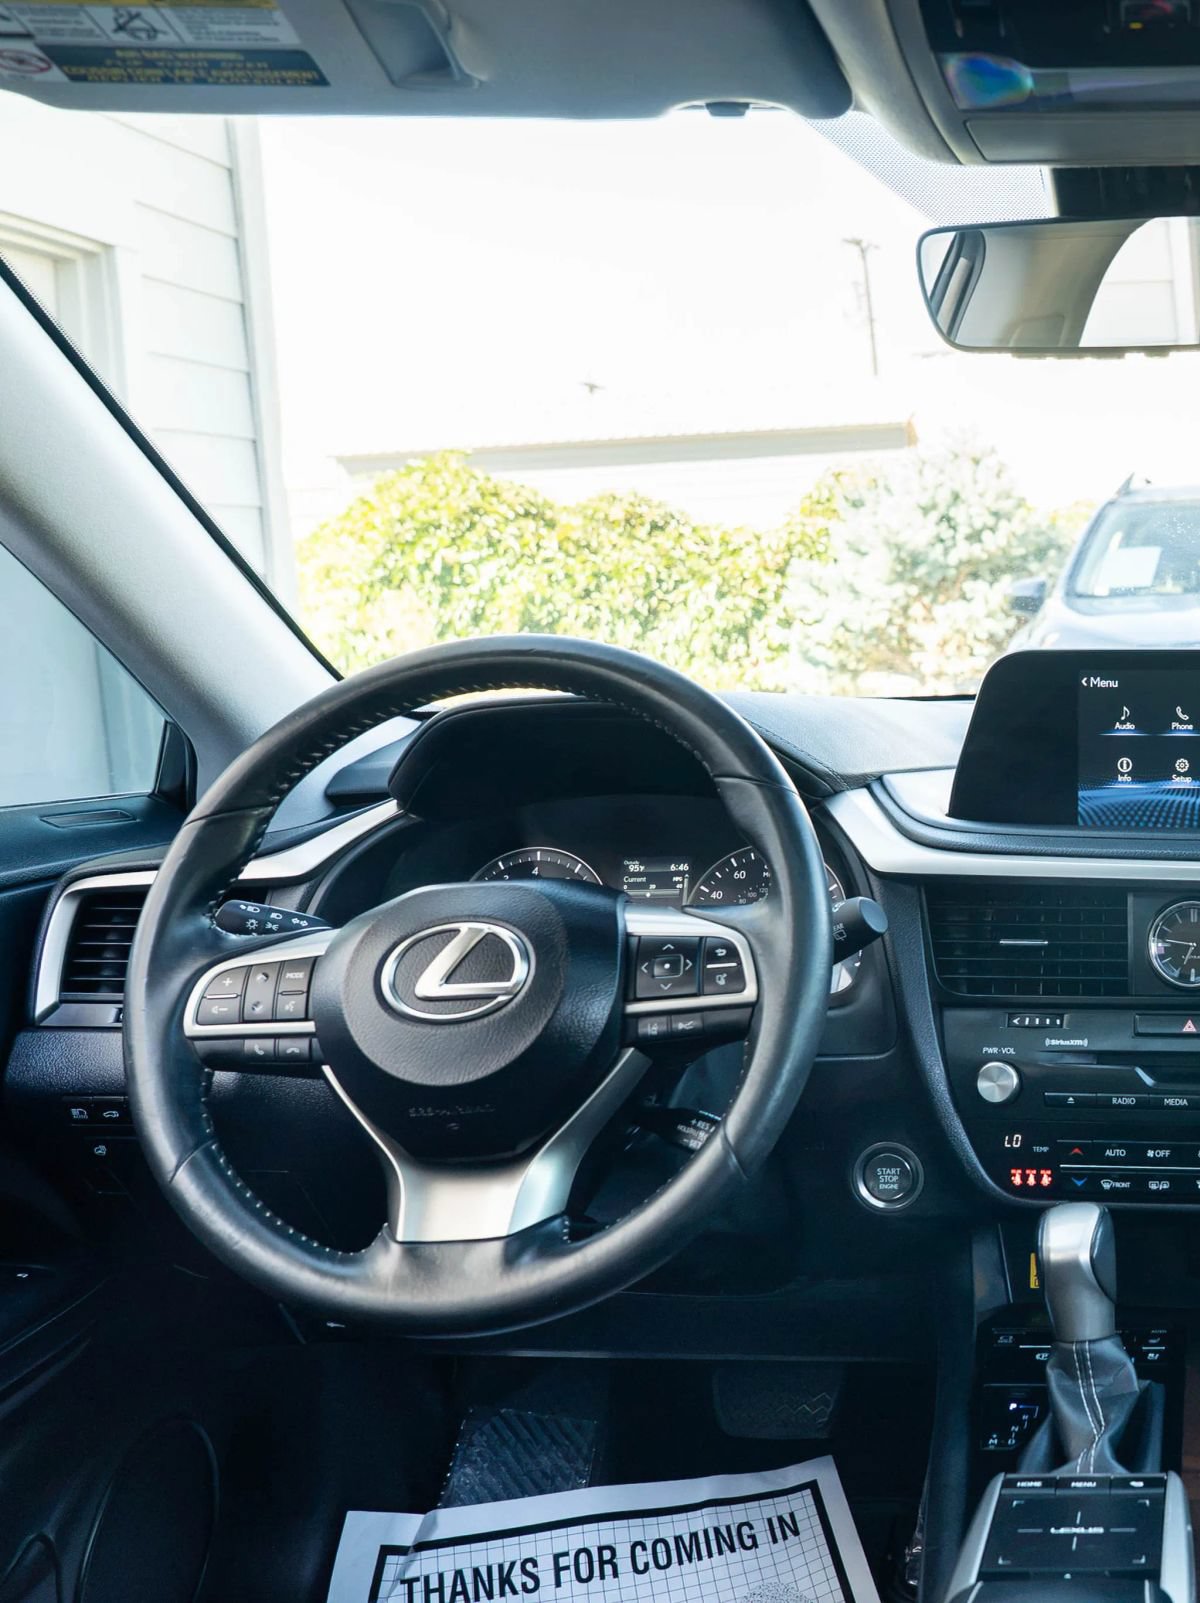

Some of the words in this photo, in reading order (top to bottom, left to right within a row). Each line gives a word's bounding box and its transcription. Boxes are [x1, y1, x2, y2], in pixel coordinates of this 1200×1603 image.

[1090, 676, 1119, 688] Menu
[1114, 722, 1136, 730] Audio
[1171, 722, 1194, 730] Phone
[1118, 774, 1132, 782] Info
[1172, 774, 1192, 784] Setup
[531, 866, 540, 876] 4
[670, 863, 690, 872] 6:46
[733, 870, 747, 880] 60
[709, 891, 724, 900] 40
[1112, 1097, 1136, 1105] RADIO
[1164, 1098, 1189, 1106] MEDIA
[1105, 1149, 1126, 1157] AUTO
[1155, 1150, 1171, 1158] OFF
[876, 1167, 901, 1175] START
[879, 1175, 899, 1183] STOP
[1112, 1181, 1131, 1189] FRONT
[1009, 1402, 1018, 1411] P
[400, 1557, 541, 1603] THANKS
[552, 1545, 619, 1588] FOR
[629, 1520, 759, 1575] COMING
[766, 1511, 801, 1545] IN
